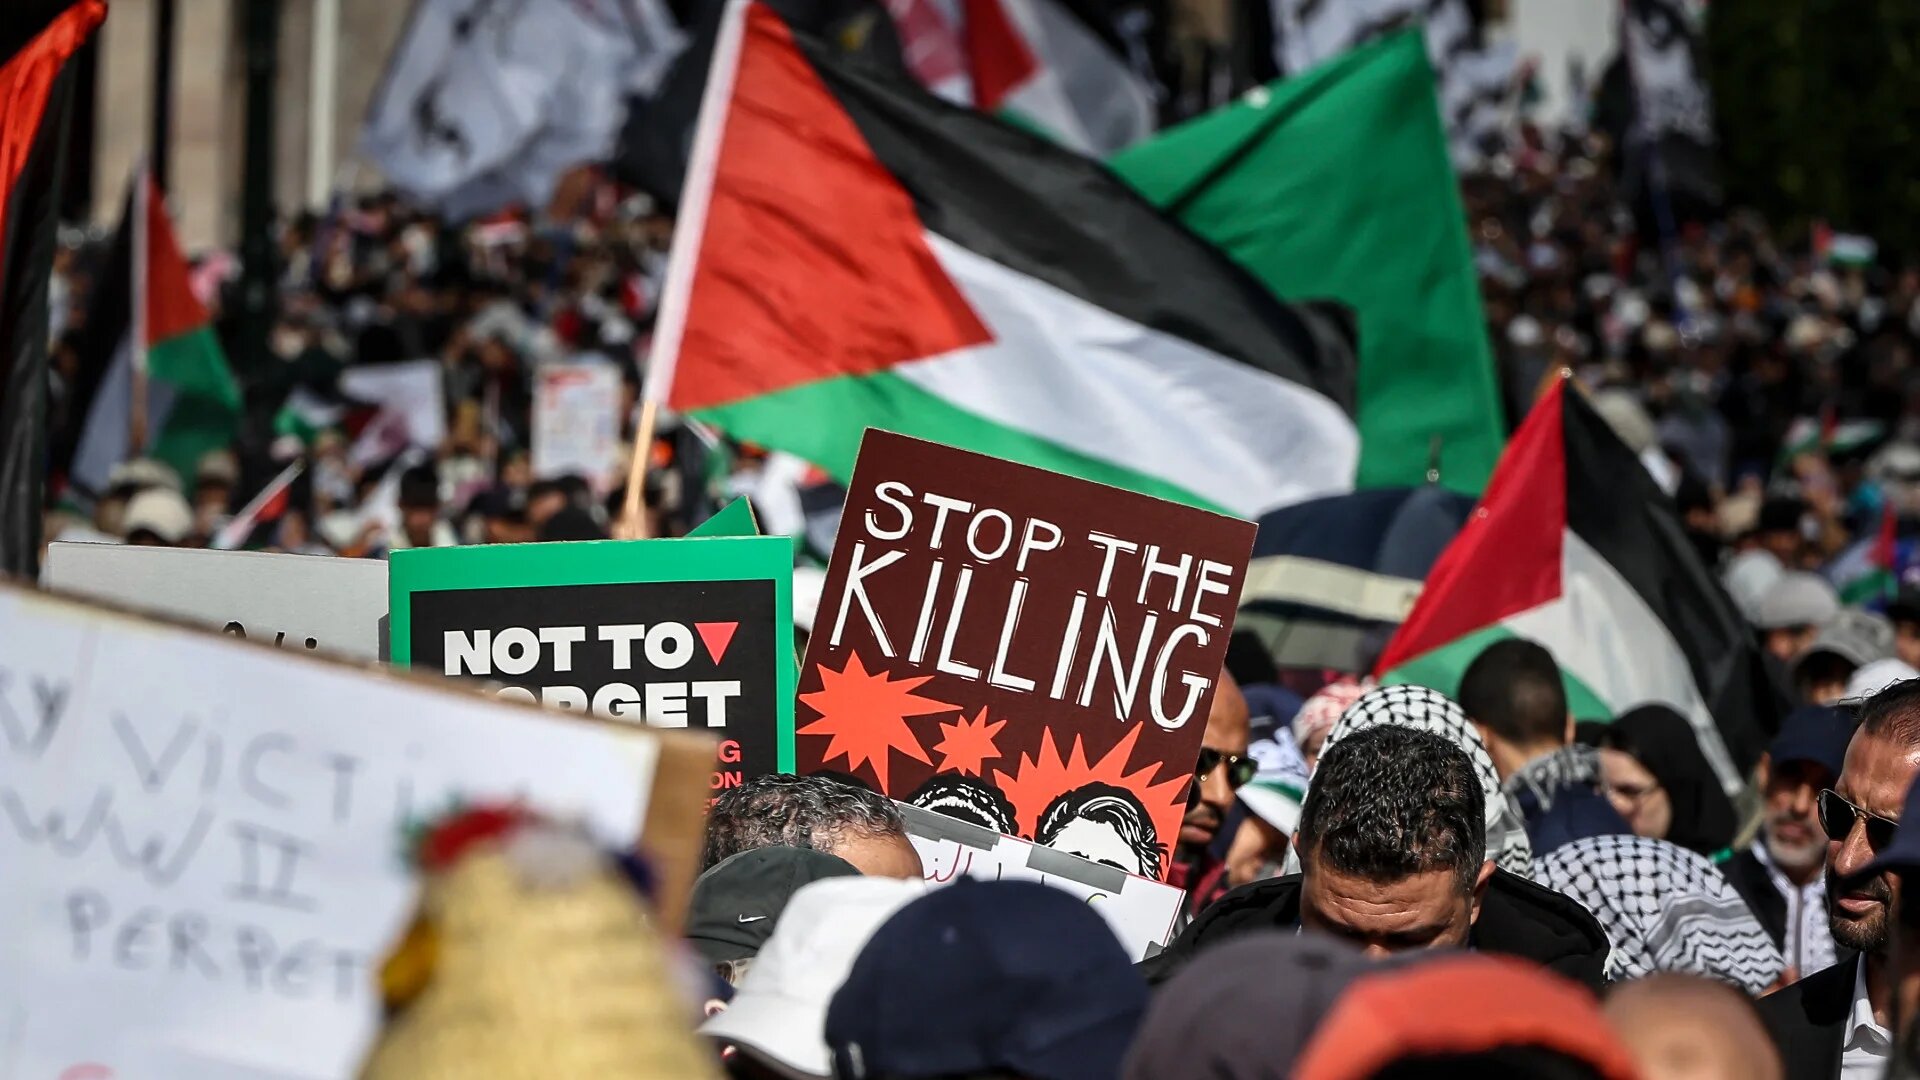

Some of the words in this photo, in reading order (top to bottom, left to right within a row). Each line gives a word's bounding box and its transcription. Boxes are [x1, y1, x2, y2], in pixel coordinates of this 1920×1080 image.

[865, 481, 1065, 572] STOP
[1088, 530, 1233, 628] THE
[444, 627, 586, 676] NOT
[598, 621, 694, 670] TO
[829, 540, 1212, 732] KILLING
[484, 680, 741, 728] RGET
[64, 886, 372, 1002] PERPET
